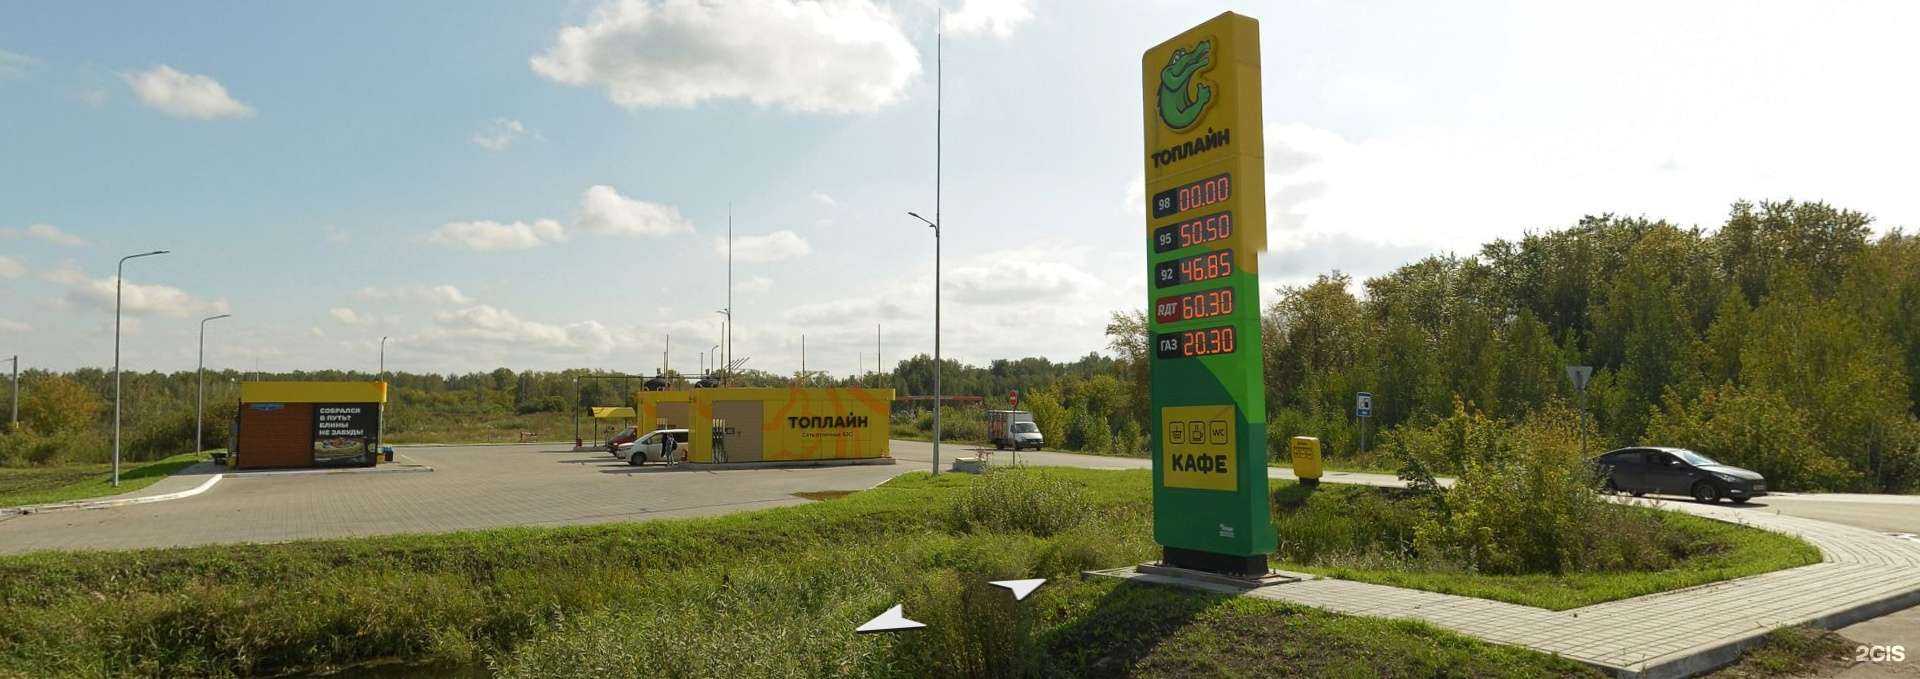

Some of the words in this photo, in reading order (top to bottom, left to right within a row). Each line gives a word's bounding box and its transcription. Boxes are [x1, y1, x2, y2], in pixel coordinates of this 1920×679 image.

[1151, 127, 1230, 168] ТОПЛАЙН
[1158, 198, 1171, 211] 98
[1179, 177, 1229, 212] 00.00
[1160, 233, 1172, 246] 95
[1181, 214, 1230, 247] 50.50
[1161, 268, 1173, 281] 92
[1182, 252, 1231, 281] 46.85
[1183, 290, 1232, 319] 60.30
[1160, 338, 1178, 352] ГАЗ
[1184, 328, 1233, 356] 20.30
[788, 412, 868, 429] ТОПЛАЙН
[1171, 453, 1228, 474] КАФЕ
